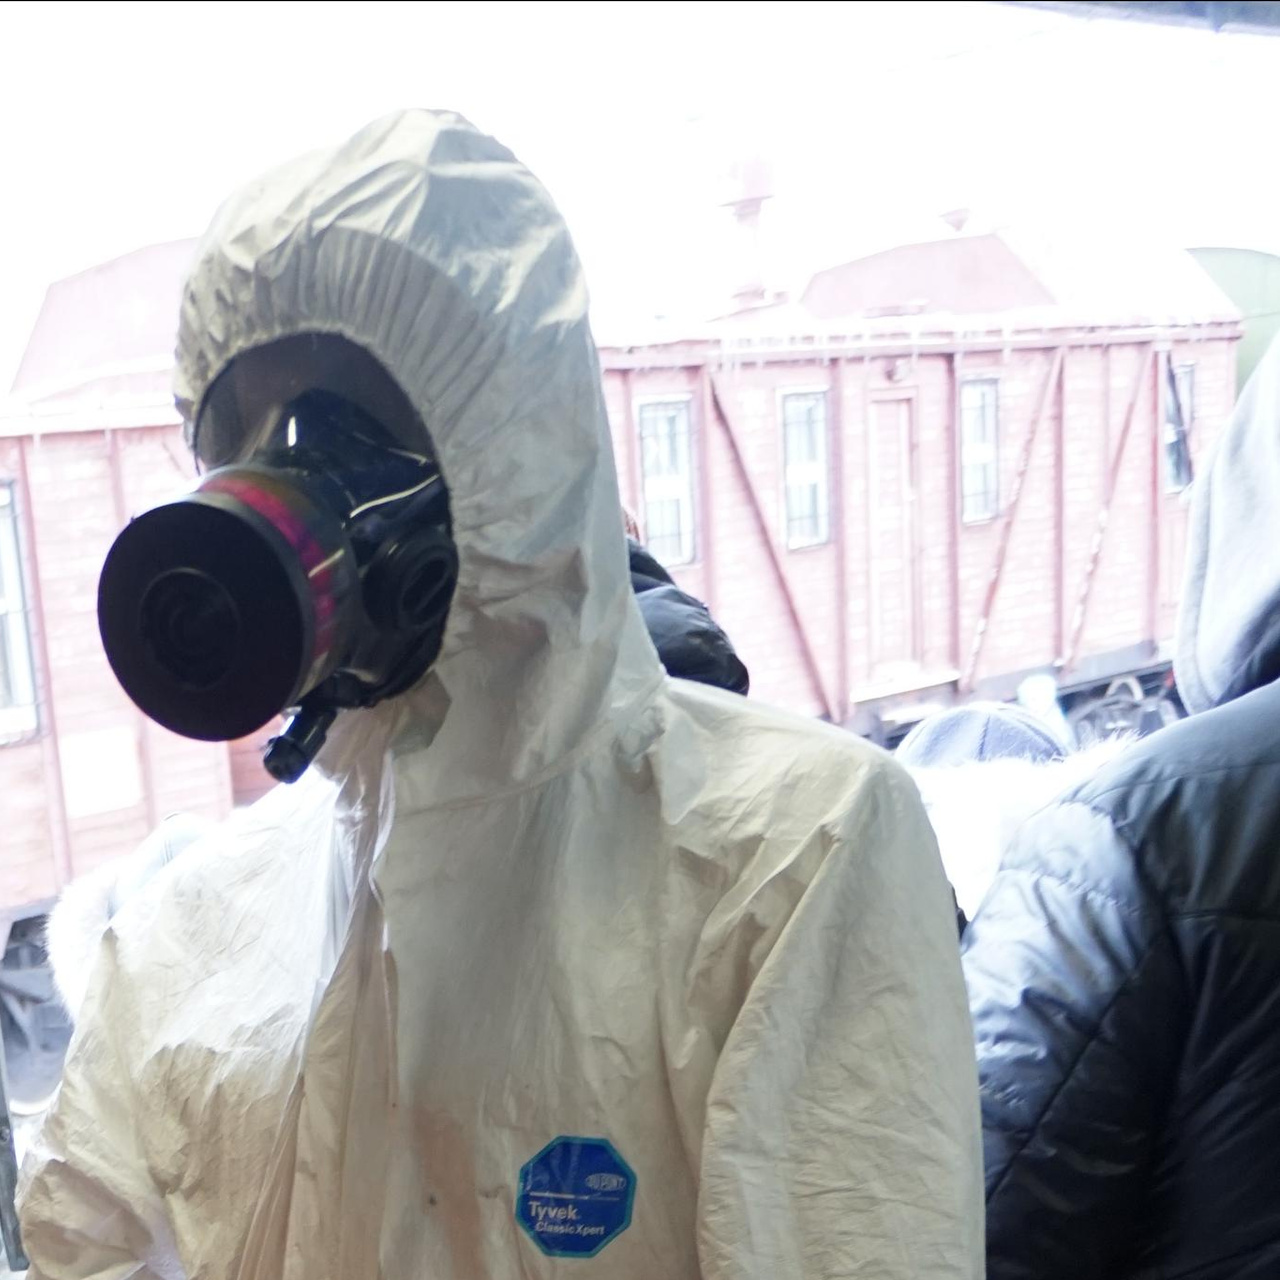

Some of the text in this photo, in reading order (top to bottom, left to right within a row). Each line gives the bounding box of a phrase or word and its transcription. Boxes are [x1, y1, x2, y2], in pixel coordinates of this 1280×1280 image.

[528, 1200, 578, 1221] Tyvek
[535, 1221, 605, 1237] Classic Xpert
